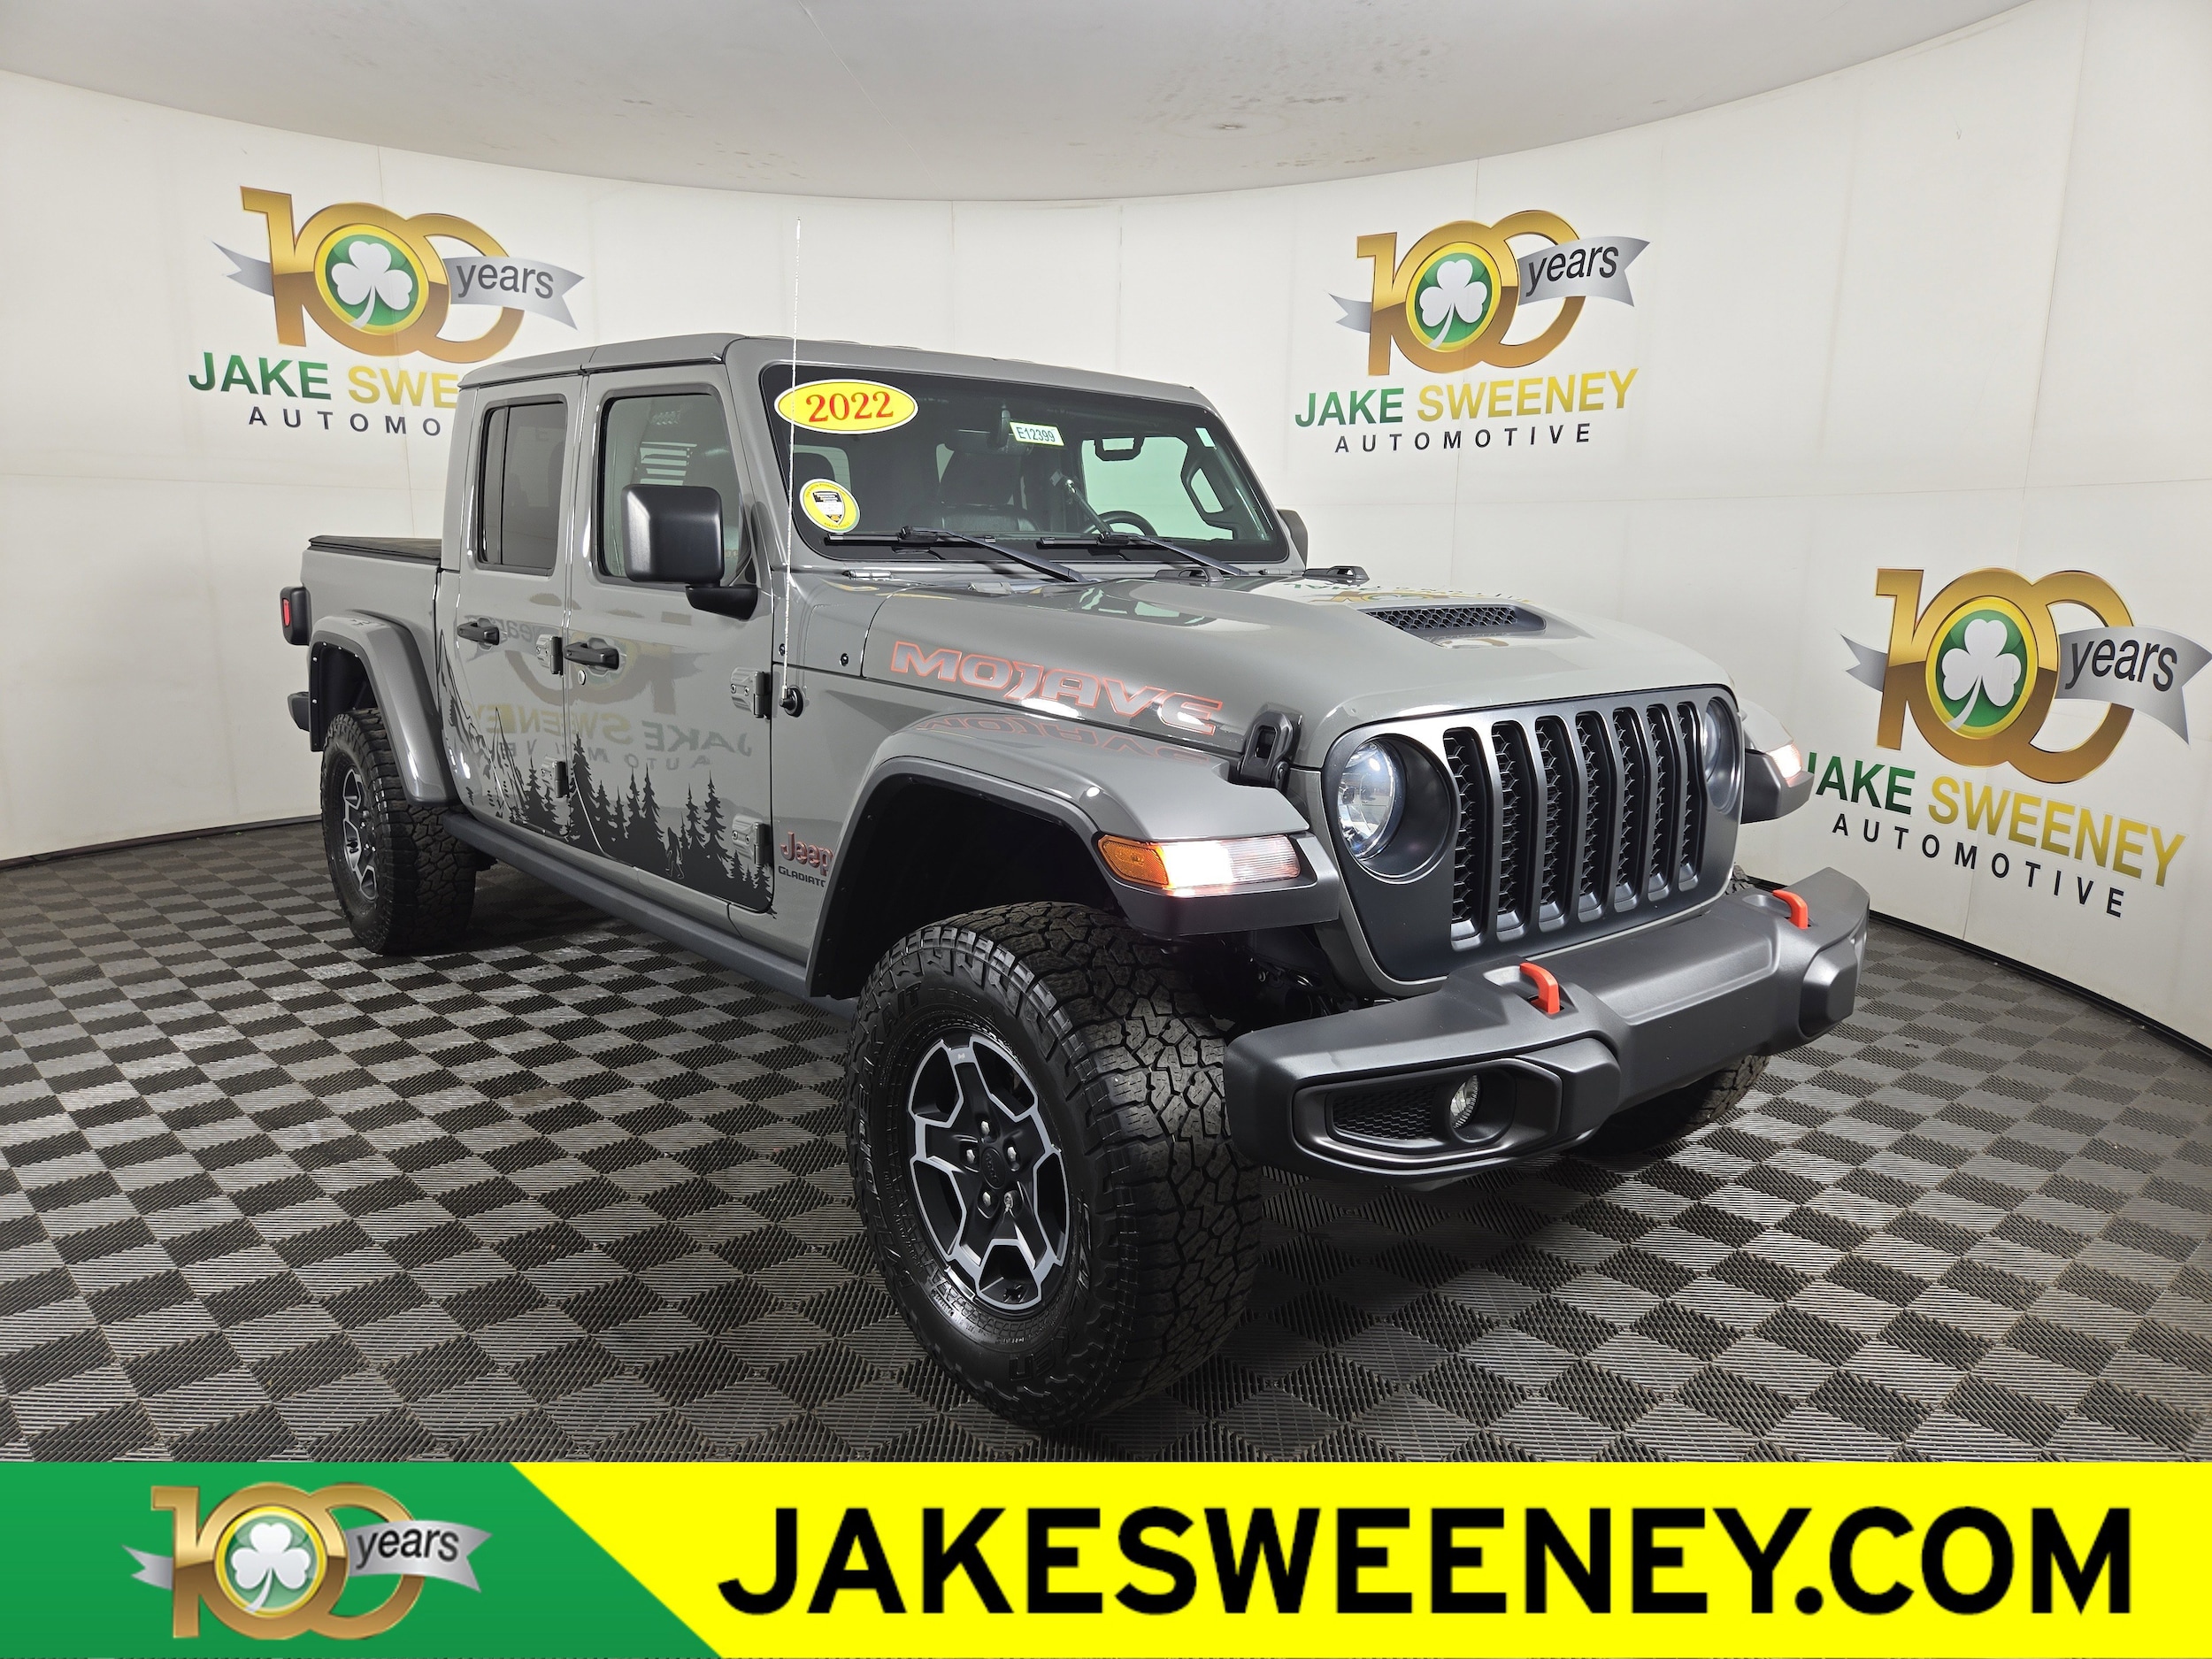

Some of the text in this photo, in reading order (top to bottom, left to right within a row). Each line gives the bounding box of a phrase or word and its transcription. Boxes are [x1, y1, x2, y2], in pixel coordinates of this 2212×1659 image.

[456, 263, 555, 300] years
[1525, 245, 1620, 298] years
[188, 350, 333, 401] JAKE
[1294, 367, 1640, 428] JAKE SWEENEY
[248, 405, 442, 436] AUTOMO
[805, 390, 895, 423] 2022
[1015, 426, 1056, 443] E12399
[1334, 422, 1591, 454] AUTOMOTIVE
[890, 640, 1224, 736] MOJAVE
[2064, 637, 2178, 692] years
[780, 831, 833, 877] Jeep
[1928, 776, 2187, 887] SWEENEY
[1832, 812, 2125, 918] AUTOMOTIVE
